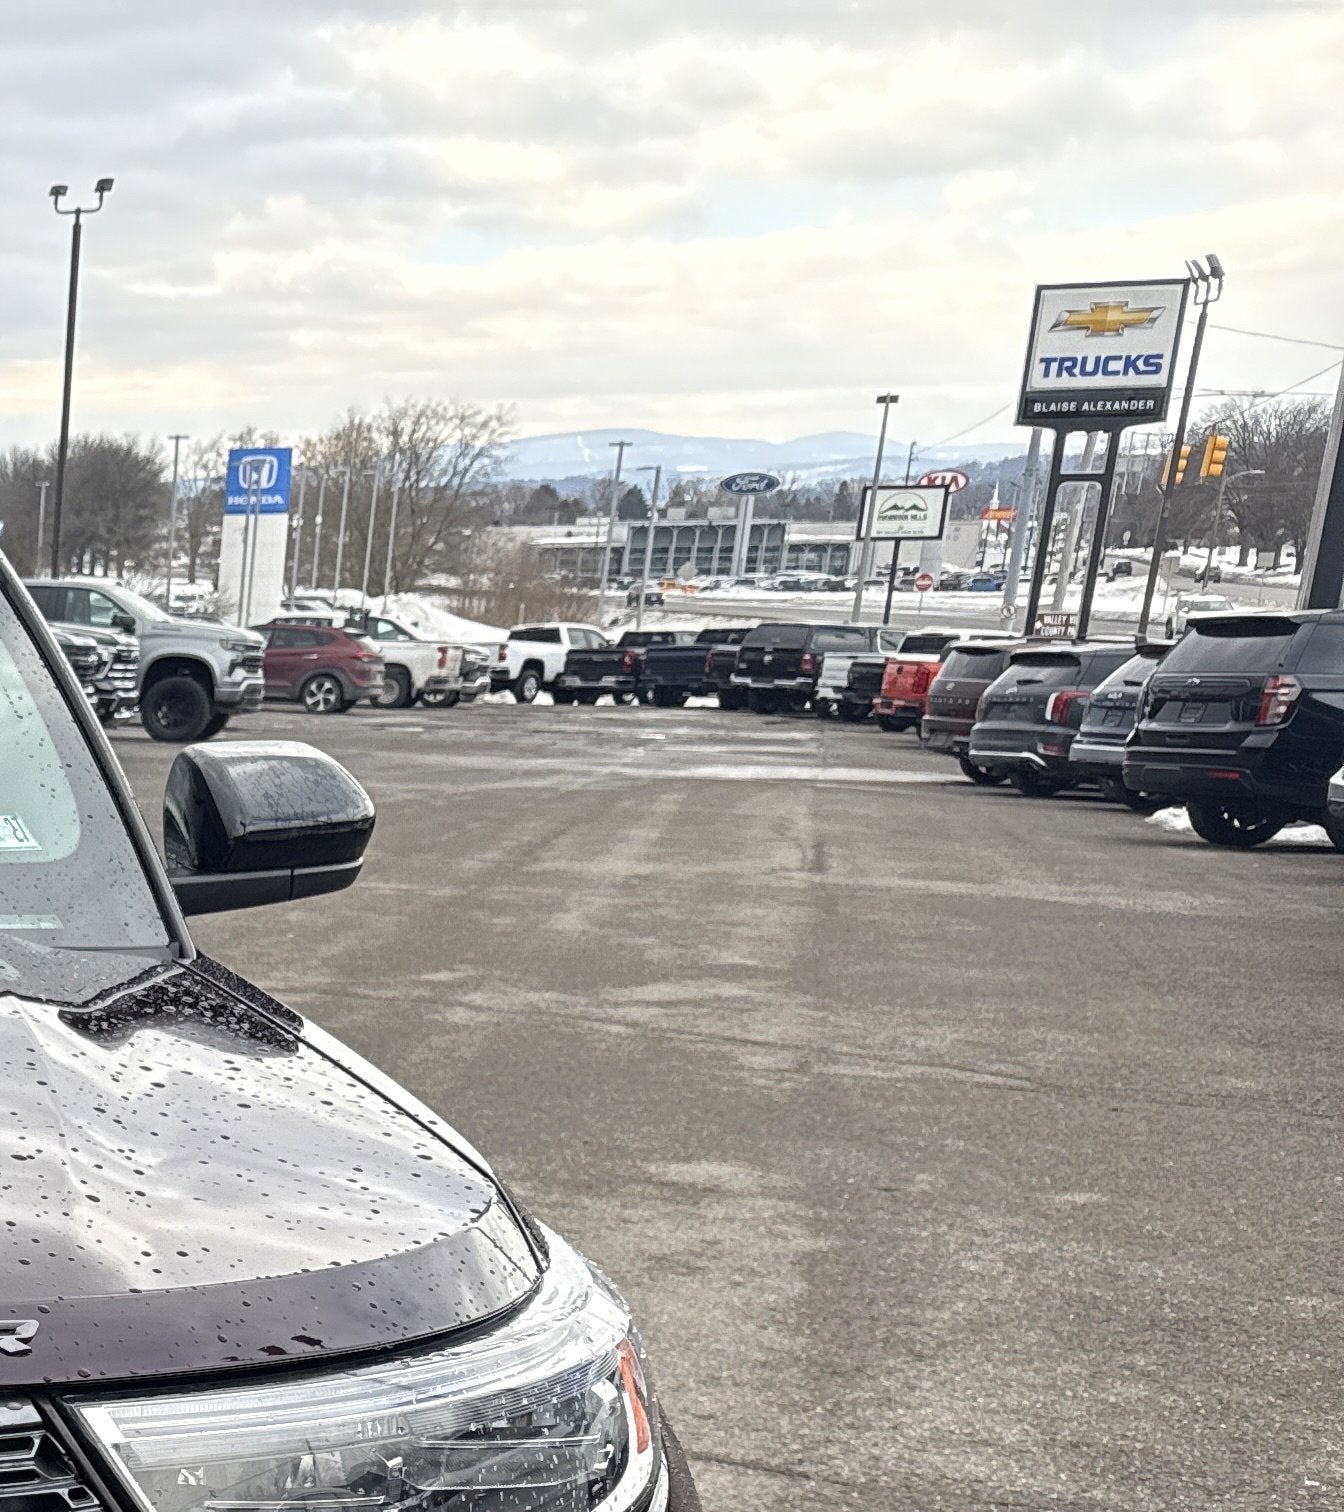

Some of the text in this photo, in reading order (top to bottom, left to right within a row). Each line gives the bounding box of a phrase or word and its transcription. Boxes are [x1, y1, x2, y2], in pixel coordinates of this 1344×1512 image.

[1039, 353, 1164, 379] TRUCKS
[1033, 399, 1155, 413] BLAISE ALEXANDER
[927, 474, 960, 490] KIA
